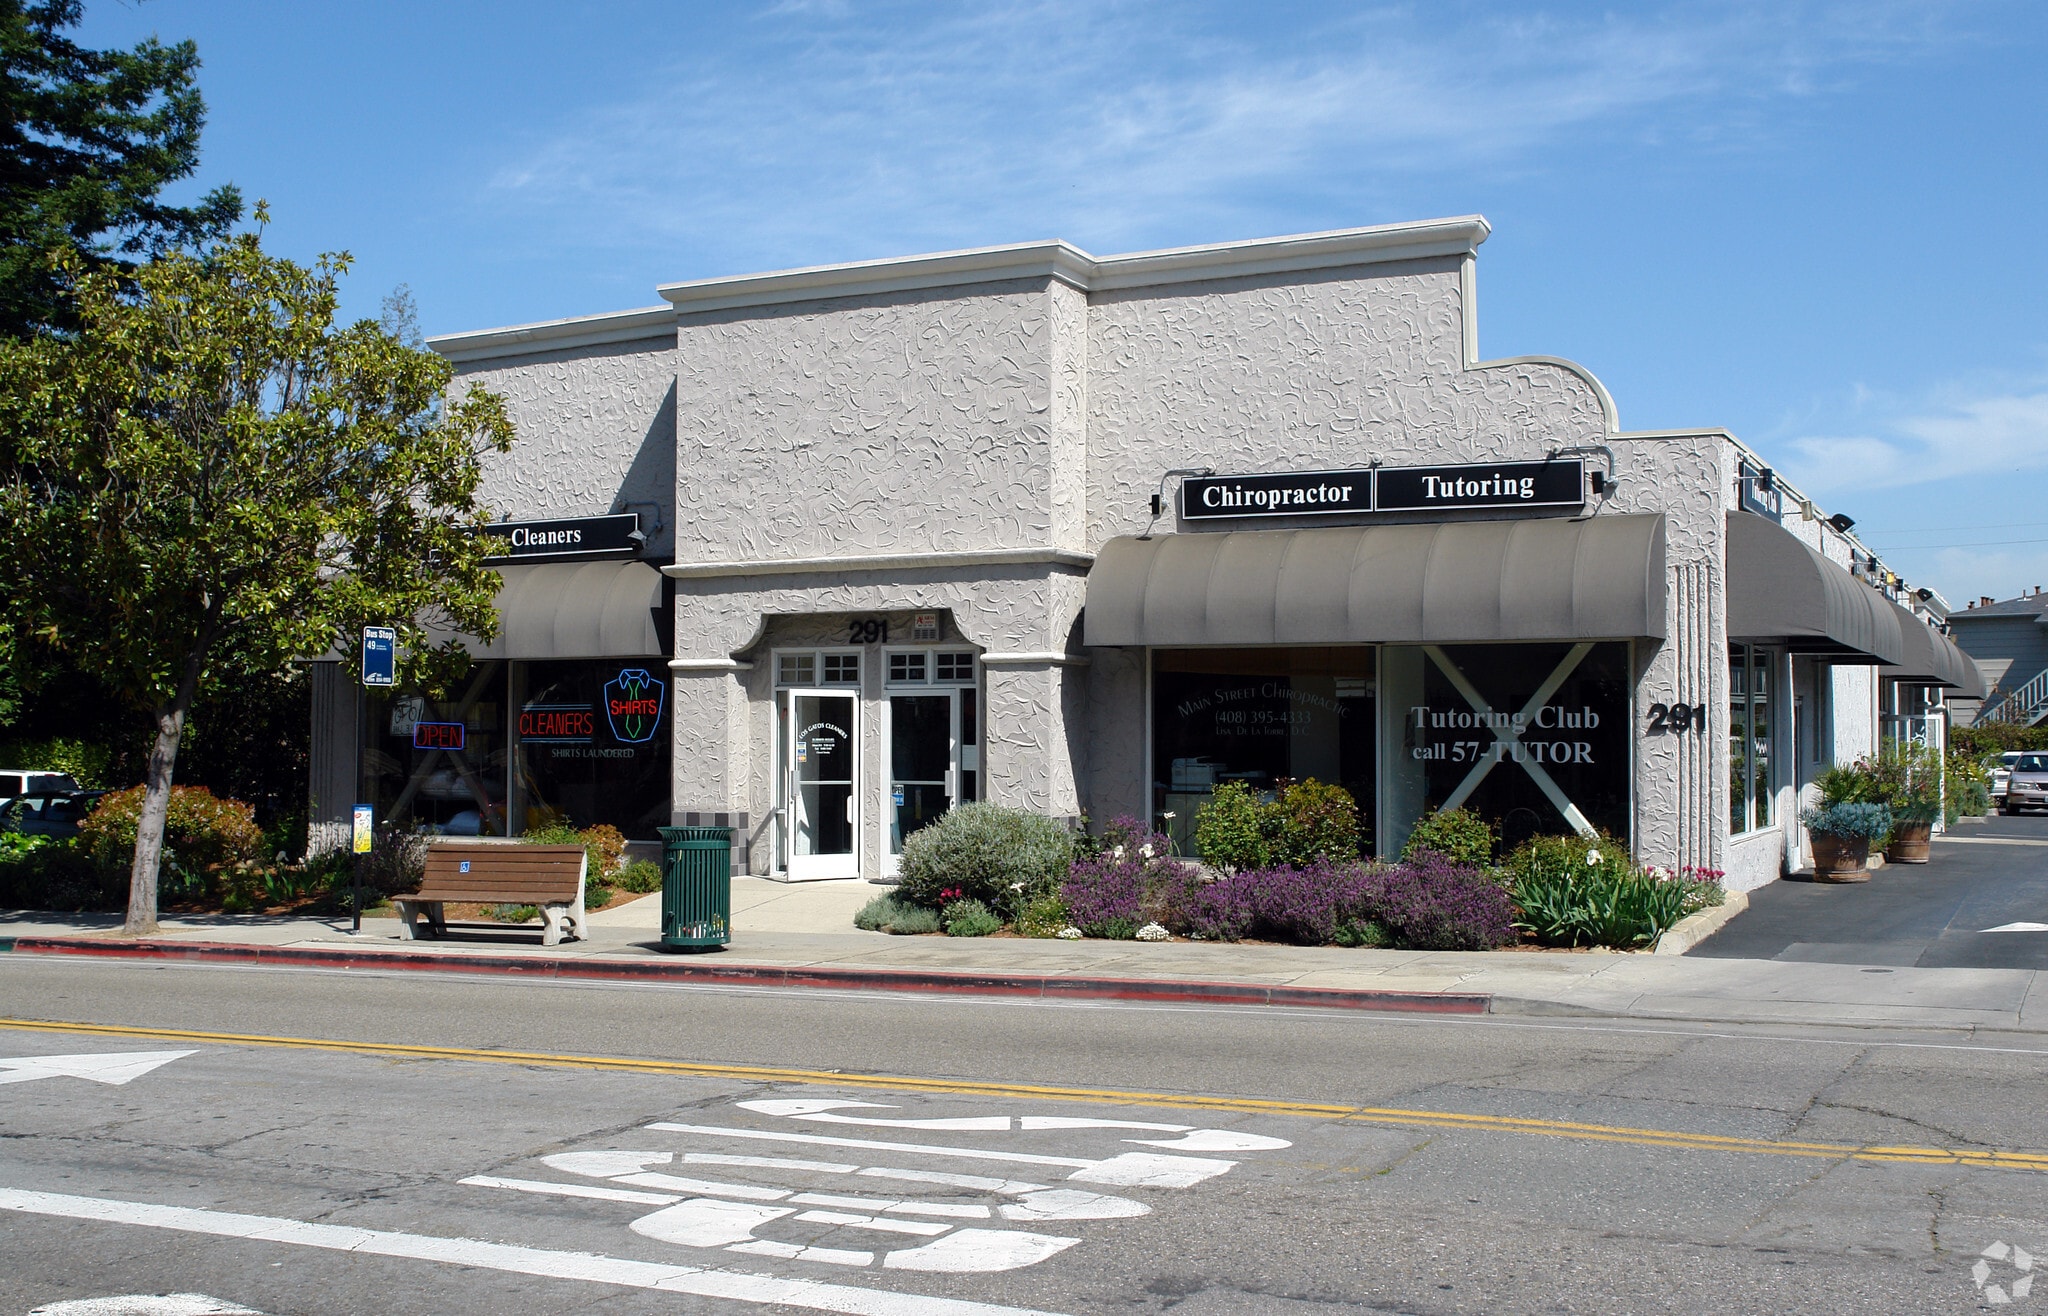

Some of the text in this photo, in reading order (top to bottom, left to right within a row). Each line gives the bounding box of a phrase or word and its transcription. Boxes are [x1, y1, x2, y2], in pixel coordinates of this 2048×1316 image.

[1203, 483, 1352, 509] Chiropractor
[1422, 473, 1535, 498] Tutoring
[511, 528, 581, 547] Cleaners
[365, 629, 393, 640] Bus Stop
[849, 619, 888, 644] 291
[367, 640, 376, 650] 49
[610, 699, 657, 716] SHIRTS
[1215, 710, 1311, 725] (408) 395-4333
[1648, 702, 1707, 732] 291
[519, 712, 593, 737] CLEANERS
[1411, 705, 1600, 734] Tutoring Club
[415, 725, 462, 747] OPEN
[551, 748, 635, 759] SHIRTS LAUNDERED
[1412, 741, 1595, 764] call 57-TUTOR
